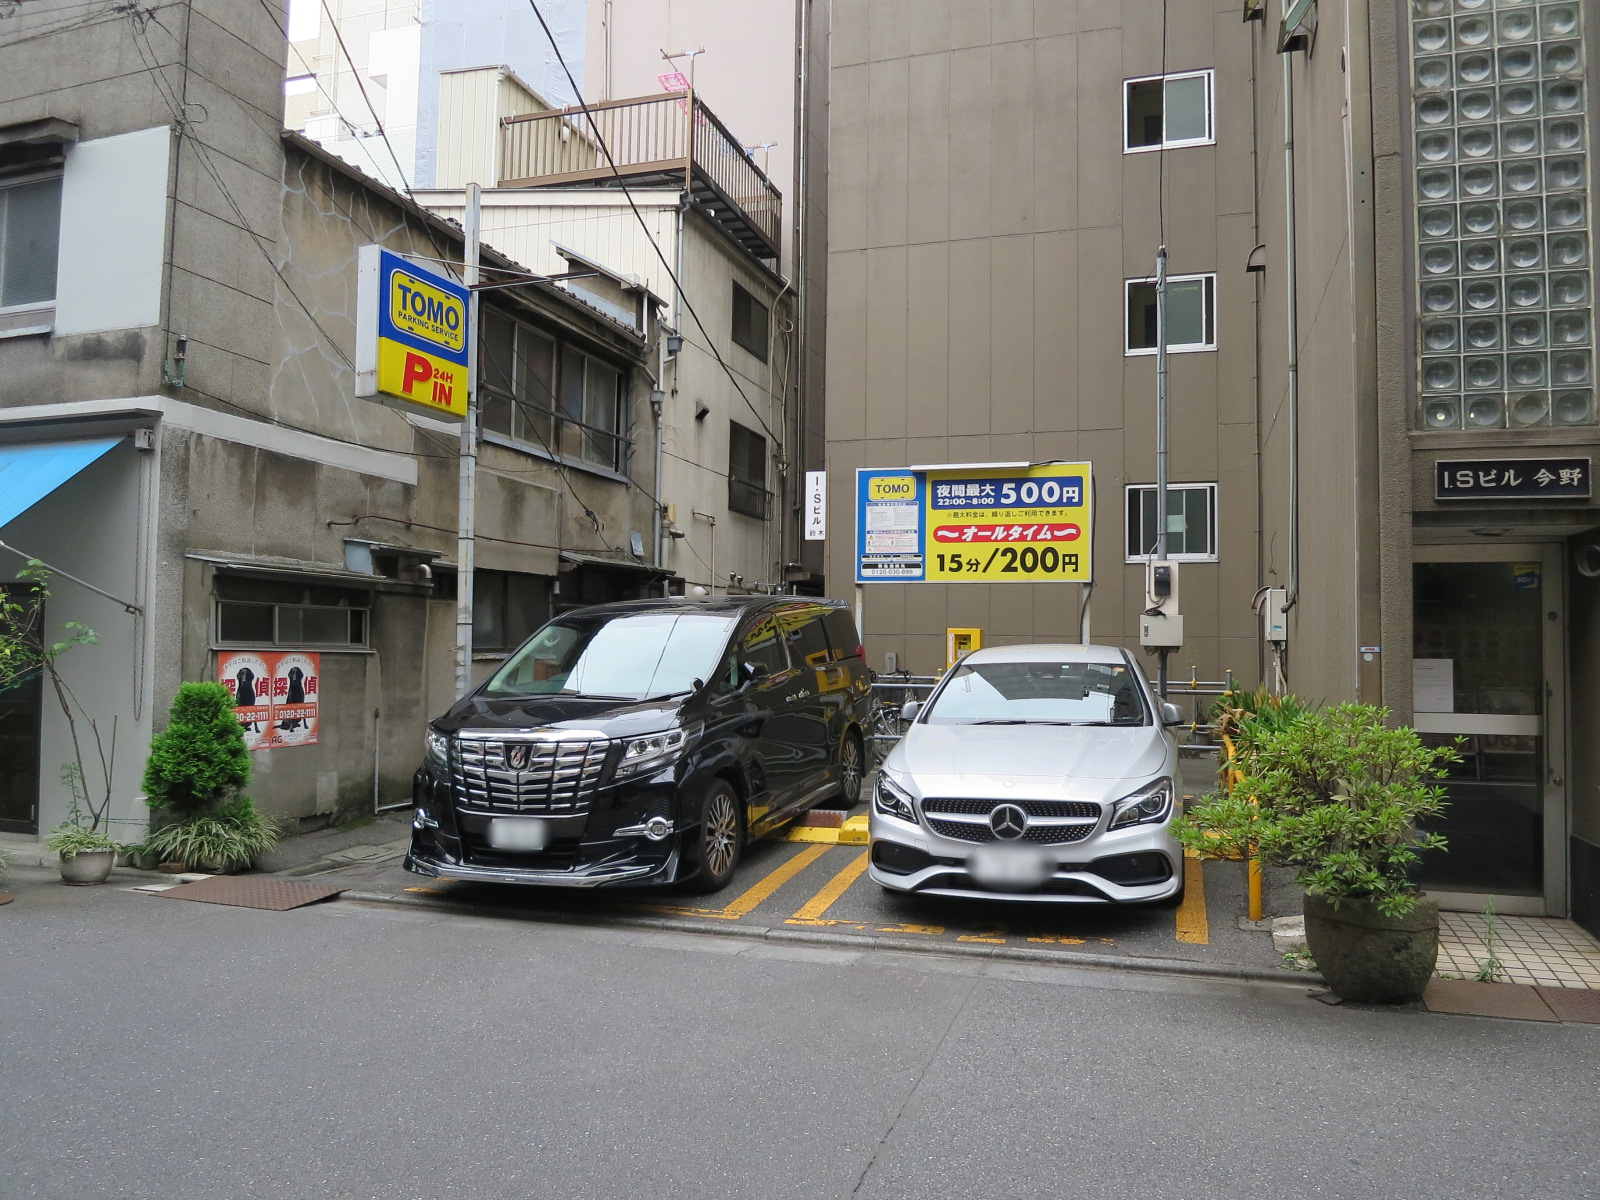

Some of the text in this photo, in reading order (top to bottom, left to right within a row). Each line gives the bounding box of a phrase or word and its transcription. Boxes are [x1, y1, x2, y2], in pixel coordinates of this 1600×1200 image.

[397, 283, 460, 331] TOMO
[398, 311, 459, 342] PARKING SERVICE
[402, 351, 433, 394] P
[433, 368, 453, 384] 24H
[432, 381, 453, 406] IN
[875, 484, 910, 494] TOMO
[1533, 468, 1583, 487] 今野
[936, 481, 1079, 504] 夜間最大 500円
[273, 676, 317, 697] 探偵
